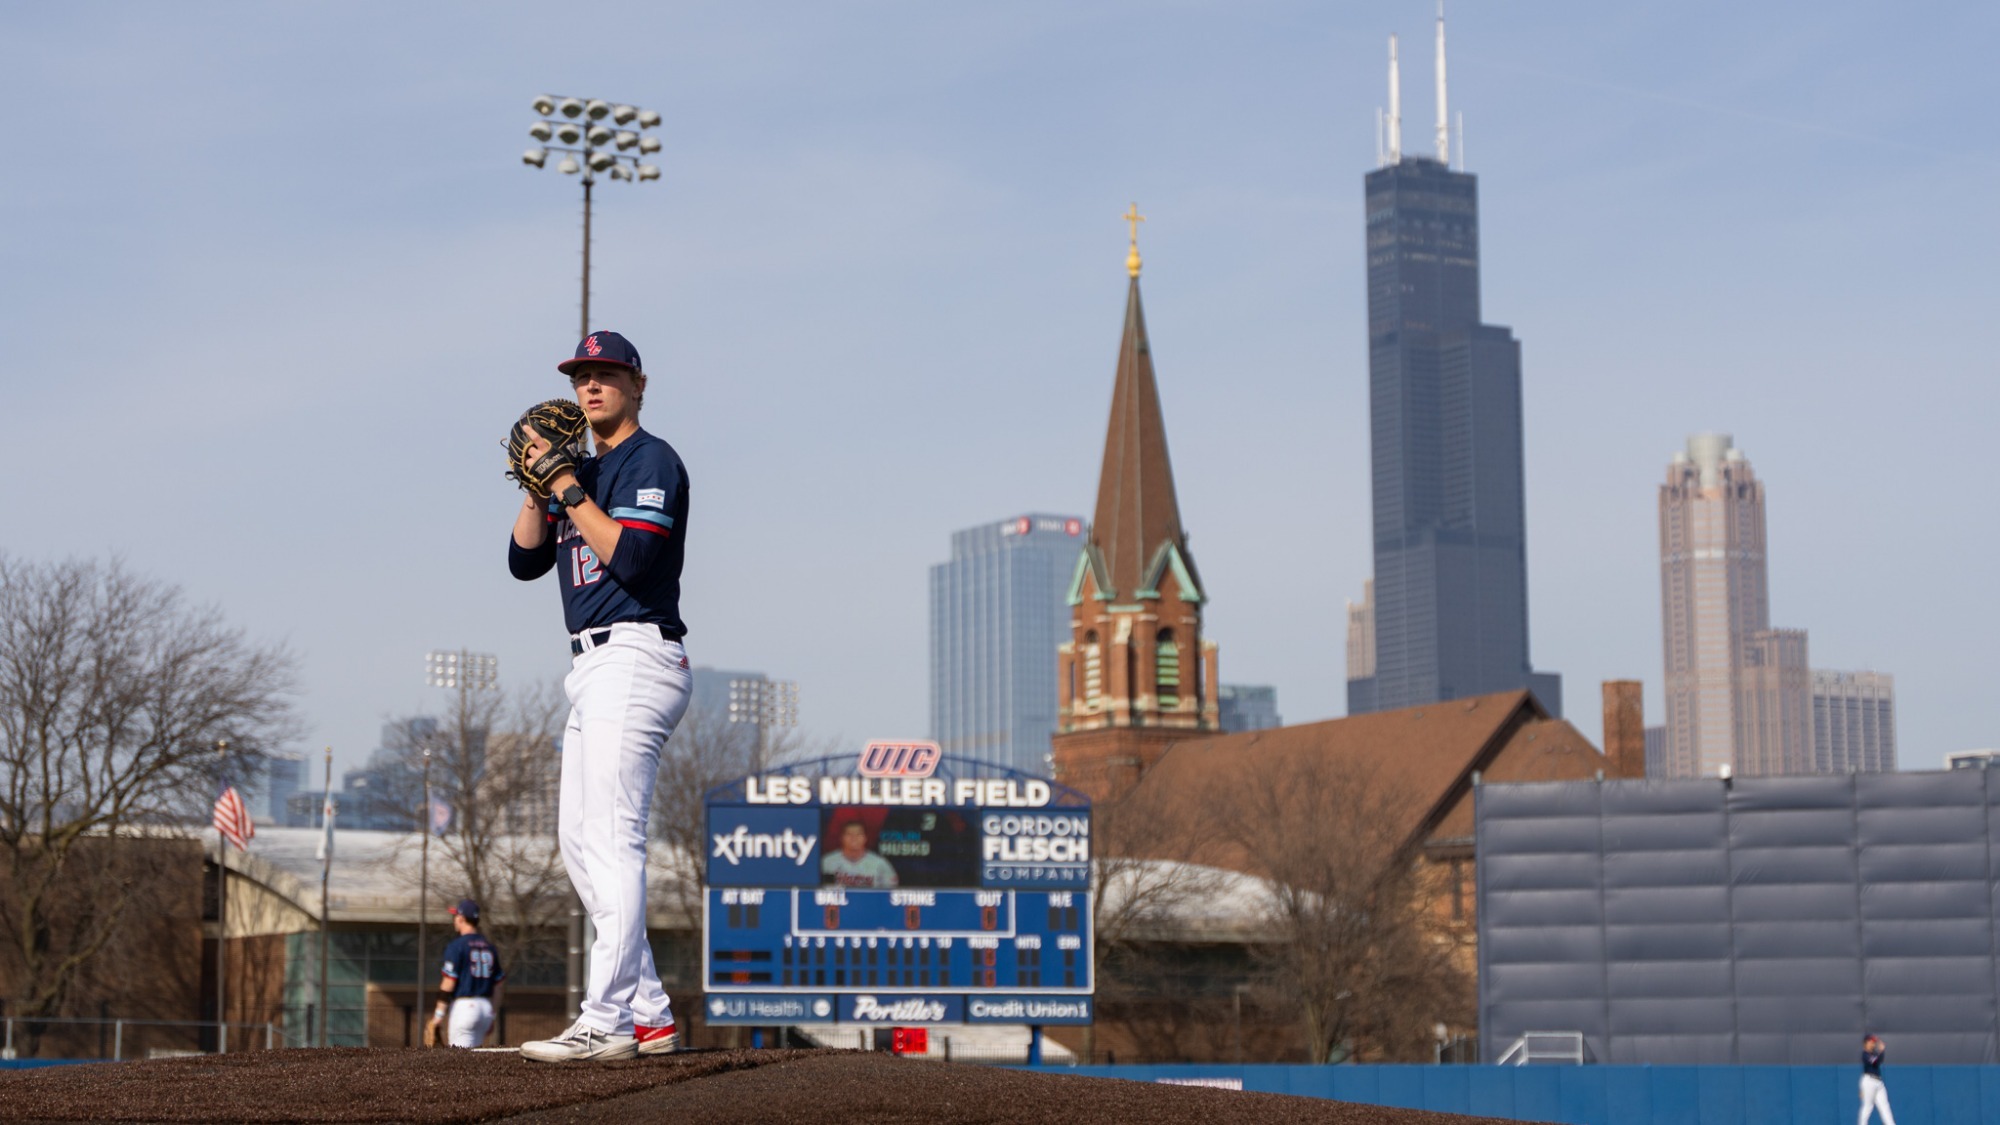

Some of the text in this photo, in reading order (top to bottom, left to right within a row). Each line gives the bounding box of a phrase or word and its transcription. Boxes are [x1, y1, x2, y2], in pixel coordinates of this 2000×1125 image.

[571, 544, 603, 587] 12
[861, 743, 938, 775] UIC
[745, 776, 1051, 807] LES MILLER FIELD
[983, 815, 1089, 836] GORDON
[713, 825, 817, 866] xfinity
[983, 837, 1089, 862] FLESCH
[984, 868, 1088, 880] COMPANY
[721, 889, 764, 905] AT BAT
[815, 888, 848, 906] BALL
[890, 890, 936, 907] STRIKE
[974, 890, 1002, 907] OUT
[726, 1000, 803, 1017] UI Health
[853, 995, 947, 1021] Portillo's
[970, 1001, 1025, 1018] Credit
